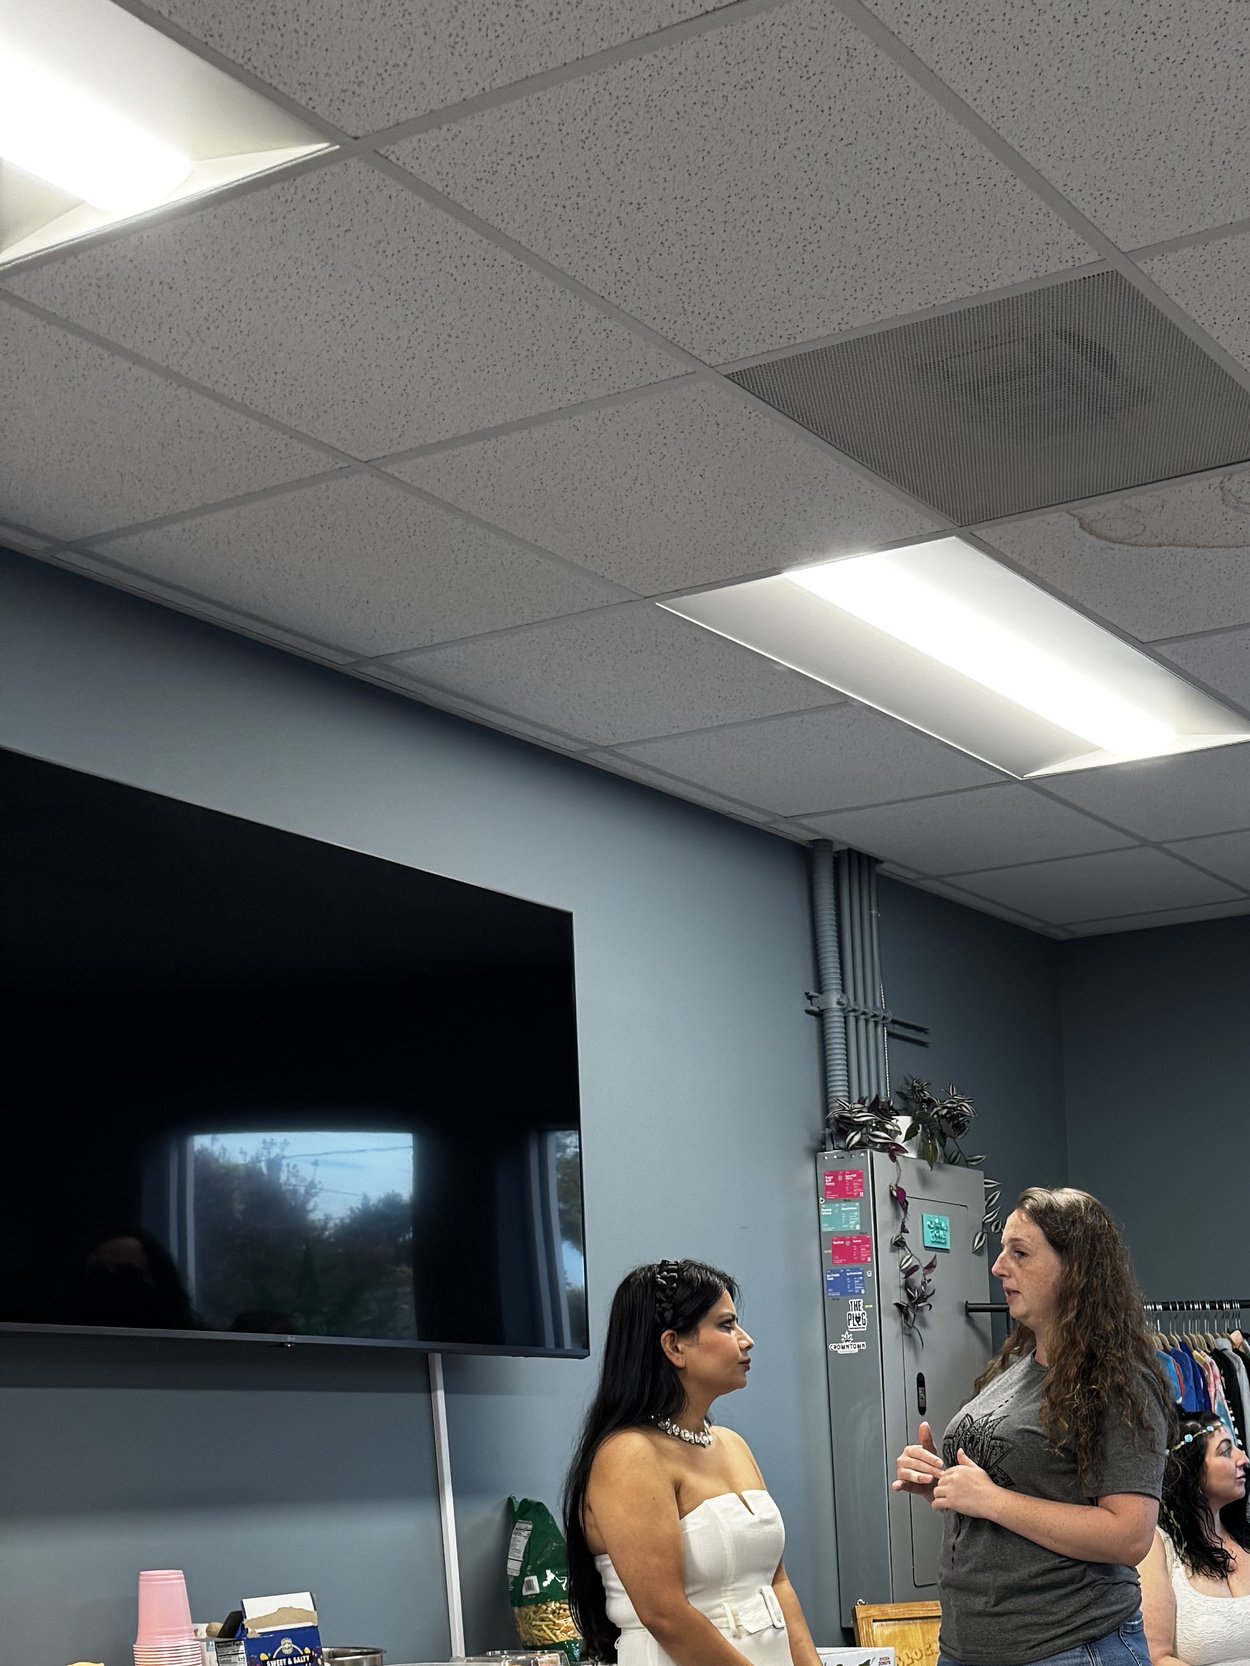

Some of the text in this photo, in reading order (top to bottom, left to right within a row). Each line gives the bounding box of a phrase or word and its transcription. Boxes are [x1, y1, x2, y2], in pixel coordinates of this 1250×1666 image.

[849, 1300, 863, 1312] THE
[848, 1312, 867, 1327] PLUG
[287, 1657, 293, 1666] &
[293, 1655, 310, 1665] SALTY
